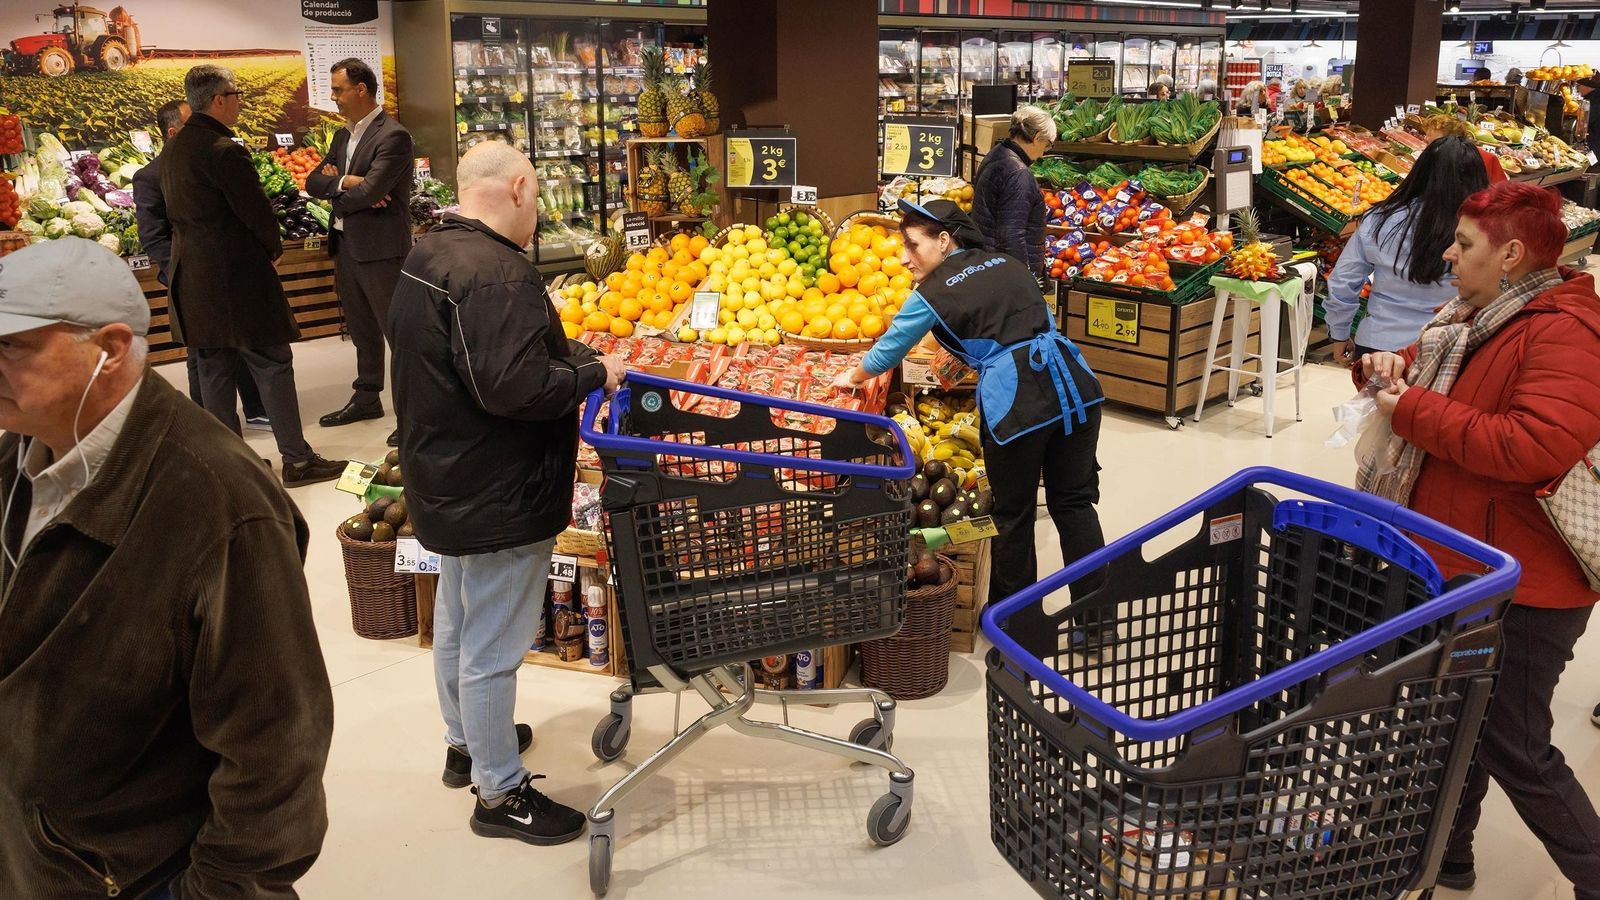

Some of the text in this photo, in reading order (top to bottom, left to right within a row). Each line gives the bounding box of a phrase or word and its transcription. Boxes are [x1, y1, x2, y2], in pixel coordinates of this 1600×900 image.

[303, 1, 340, 9] Calendari
[315, 10, 352, 18] producció
[1475, 43, 1488, 53] 34
[1094, 70, 1108, 78] 2x1
[919, 132, 926, 142] 2
[929, 133, 942, 145] kg
[761, 145, 783, 157] 2 kg
[590, 624, 605, 632] ATO
